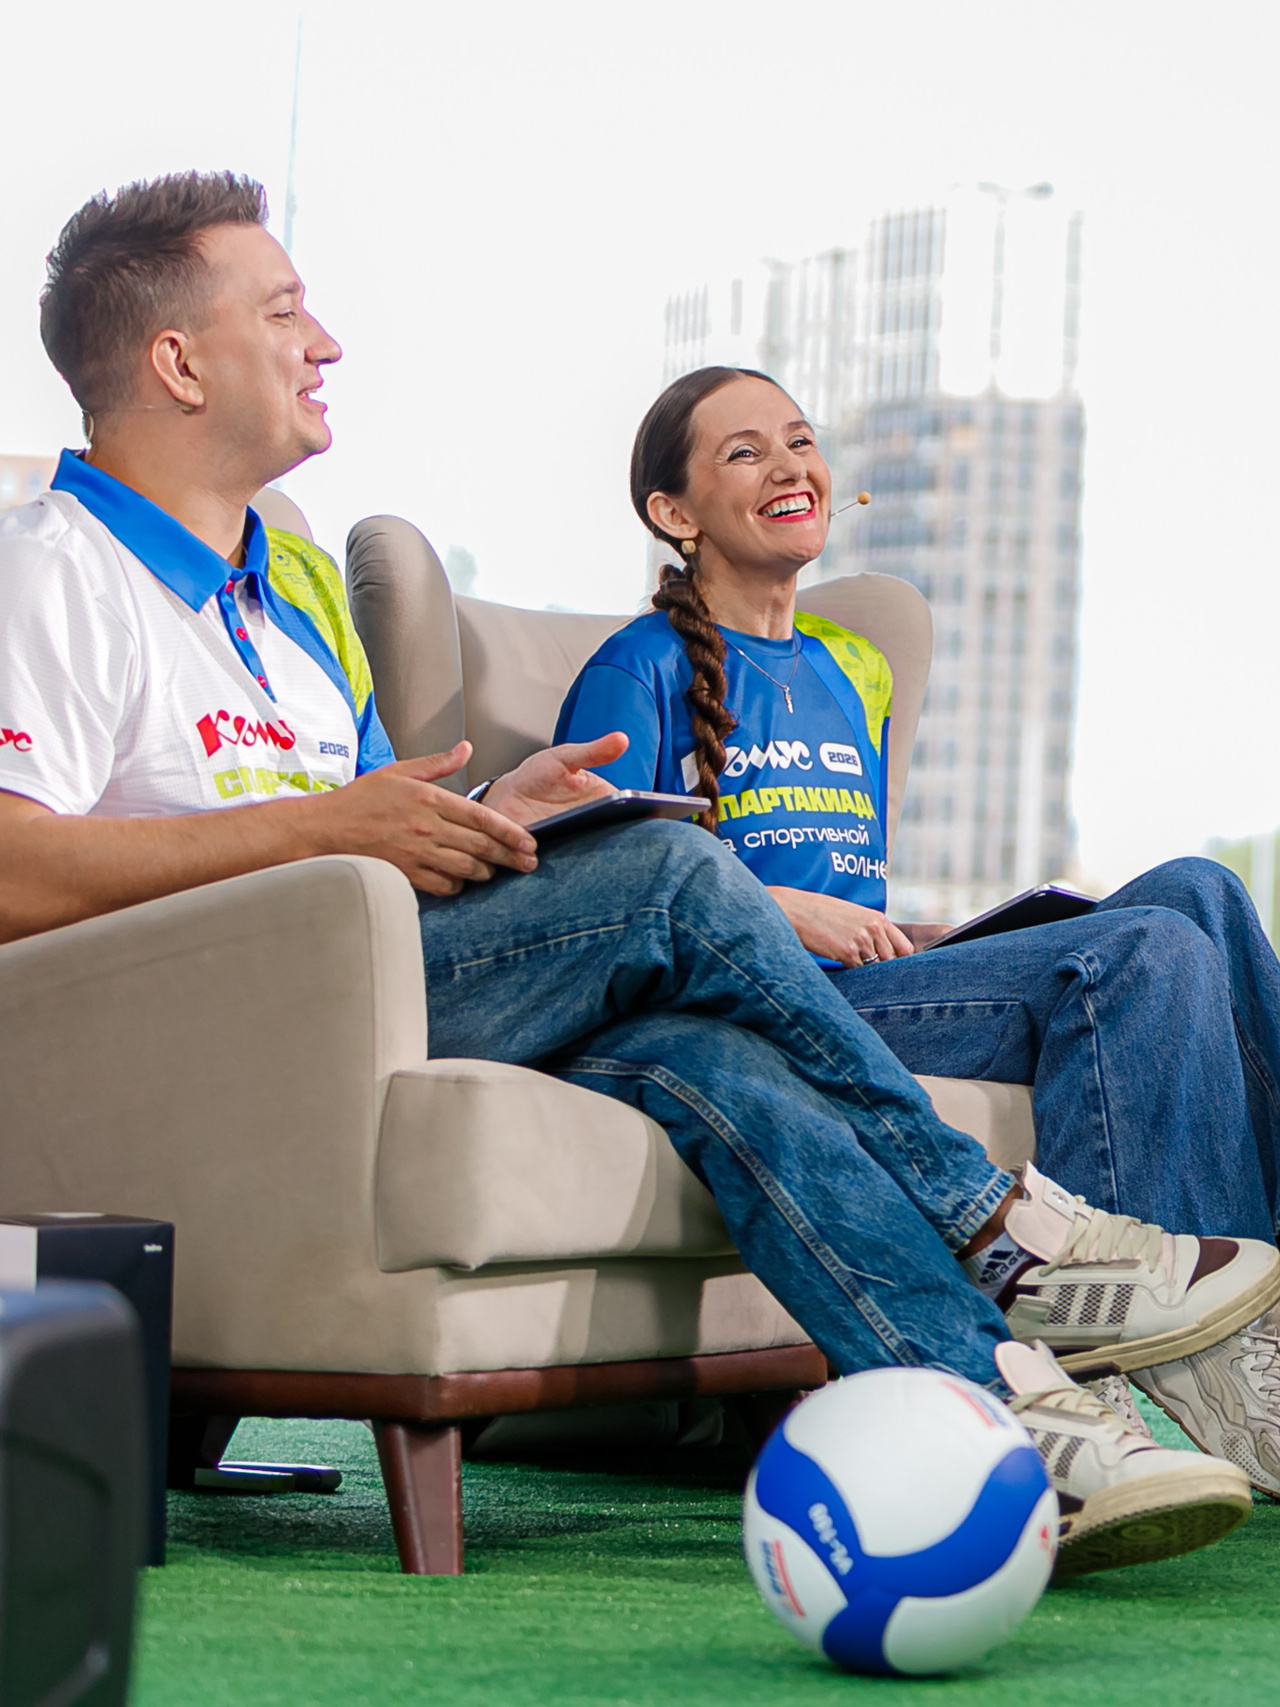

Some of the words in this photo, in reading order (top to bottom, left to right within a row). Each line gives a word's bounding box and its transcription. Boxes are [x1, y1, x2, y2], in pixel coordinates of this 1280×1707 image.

[318, 741, 350, 759] 2026
[692, 786, 877, 822] ПАРТАКИАДА
[743, 824, 870, 850] спортивной
